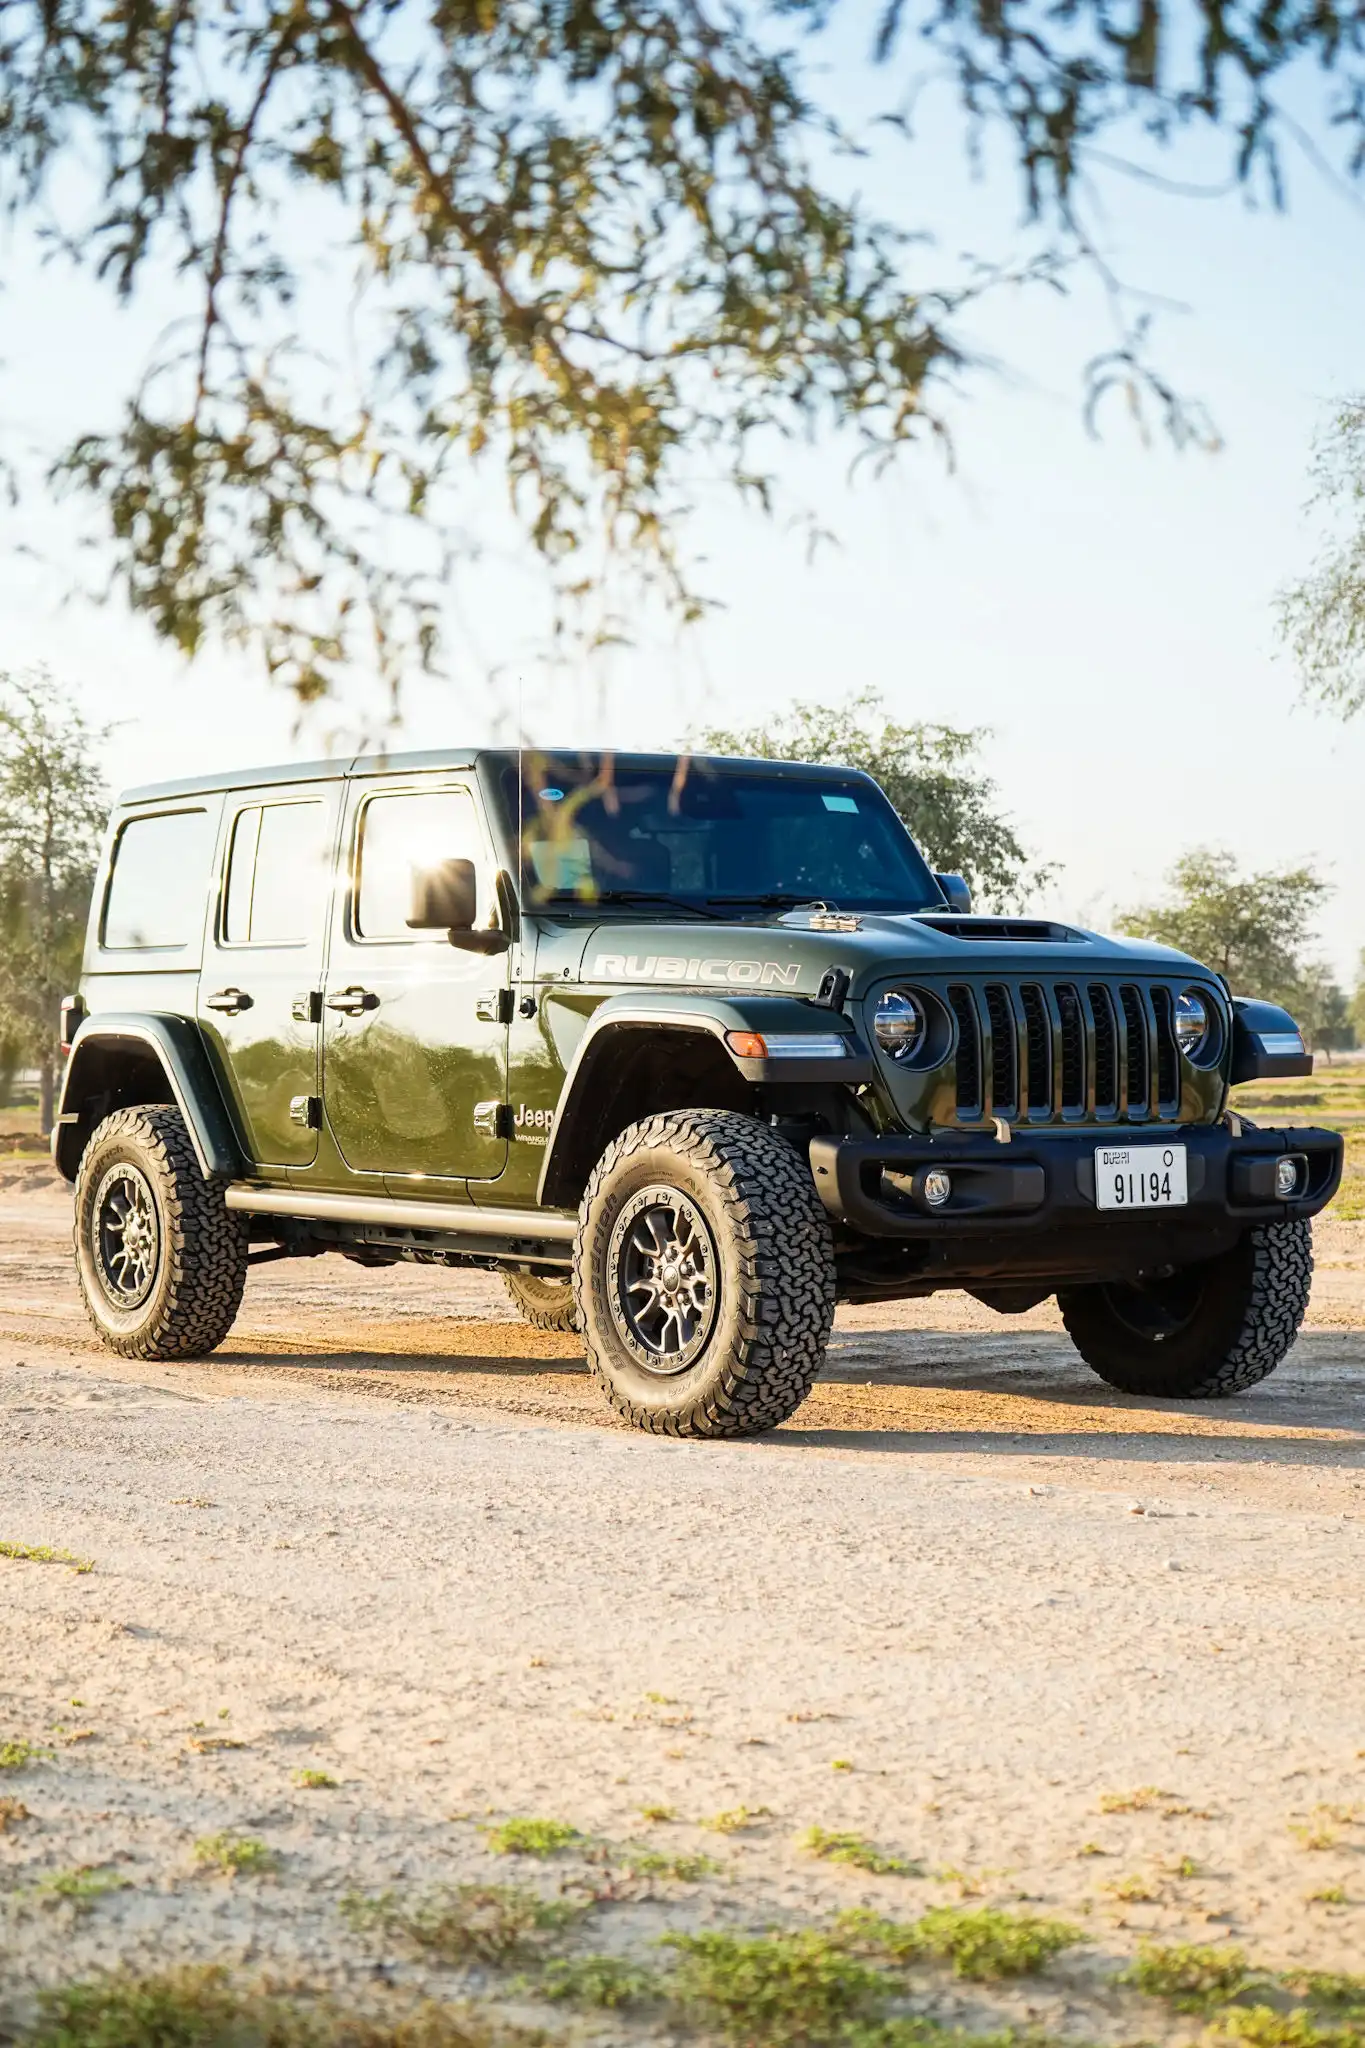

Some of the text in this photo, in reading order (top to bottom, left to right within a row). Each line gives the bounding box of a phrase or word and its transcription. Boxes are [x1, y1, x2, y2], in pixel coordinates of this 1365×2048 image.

[592, 954, 802, 986] RUBICON
[513, 1103, 555, 1133] Jeep
[1114, 1172, 1172, 1204] 91194
